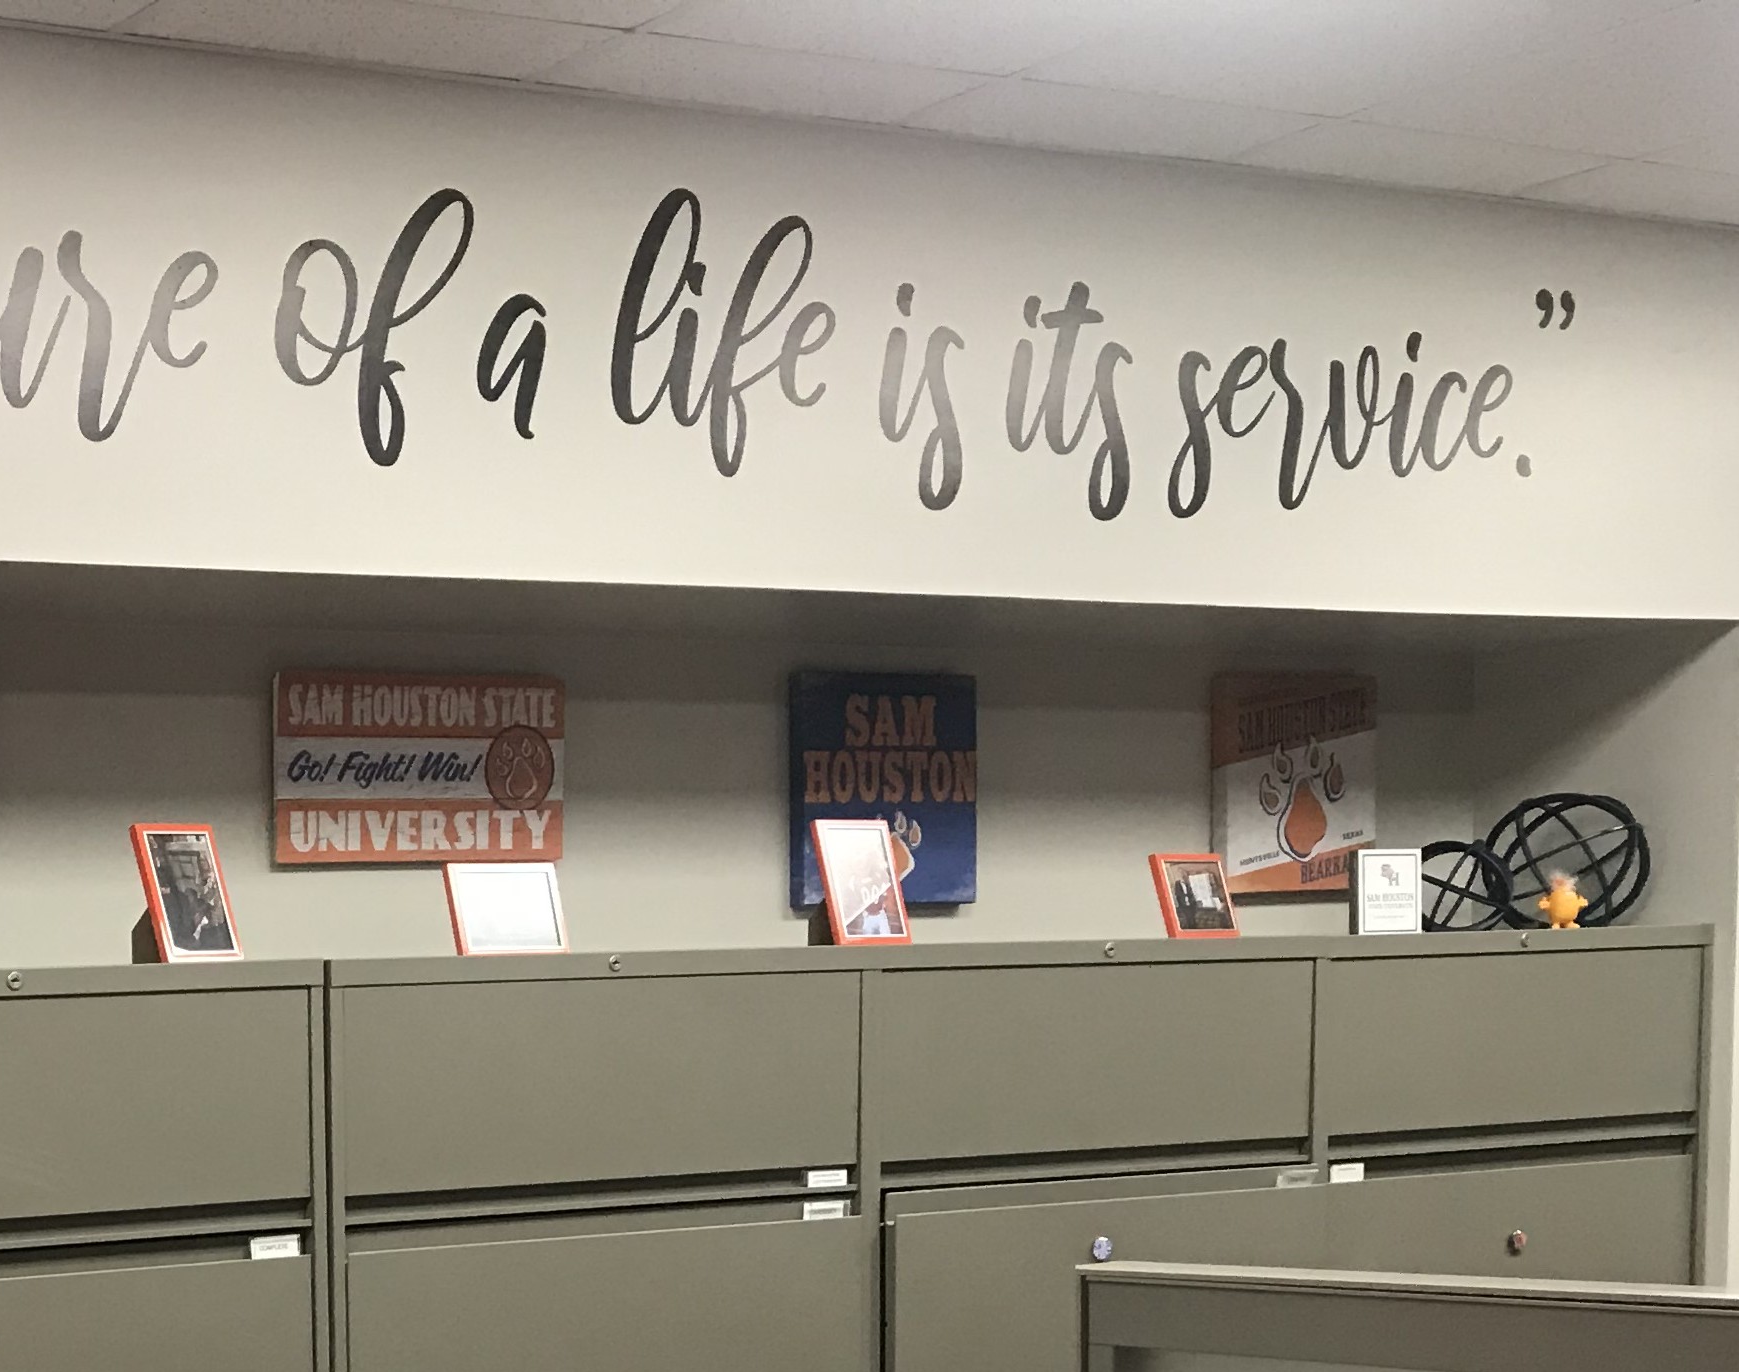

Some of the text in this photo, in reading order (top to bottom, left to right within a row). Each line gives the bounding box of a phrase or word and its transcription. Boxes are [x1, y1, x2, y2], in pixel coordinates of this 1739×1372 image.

[272, 187, 474, 468] of
[476, 292, 549, 440] a
[611, 187, 837, 478] life
[877, 282, 964, 512] is
[1005, 281, 1136, 523] its
[288, 683, 557, 730] SAM HOUSTON STATE
[844, 692, 937, 747] SAM
[286, 750, 482, 790] Go! Fight! Win!
[802, 750, 977, 804] HOUSTON
[289, 809, 552, 853] UNIVERSITY
